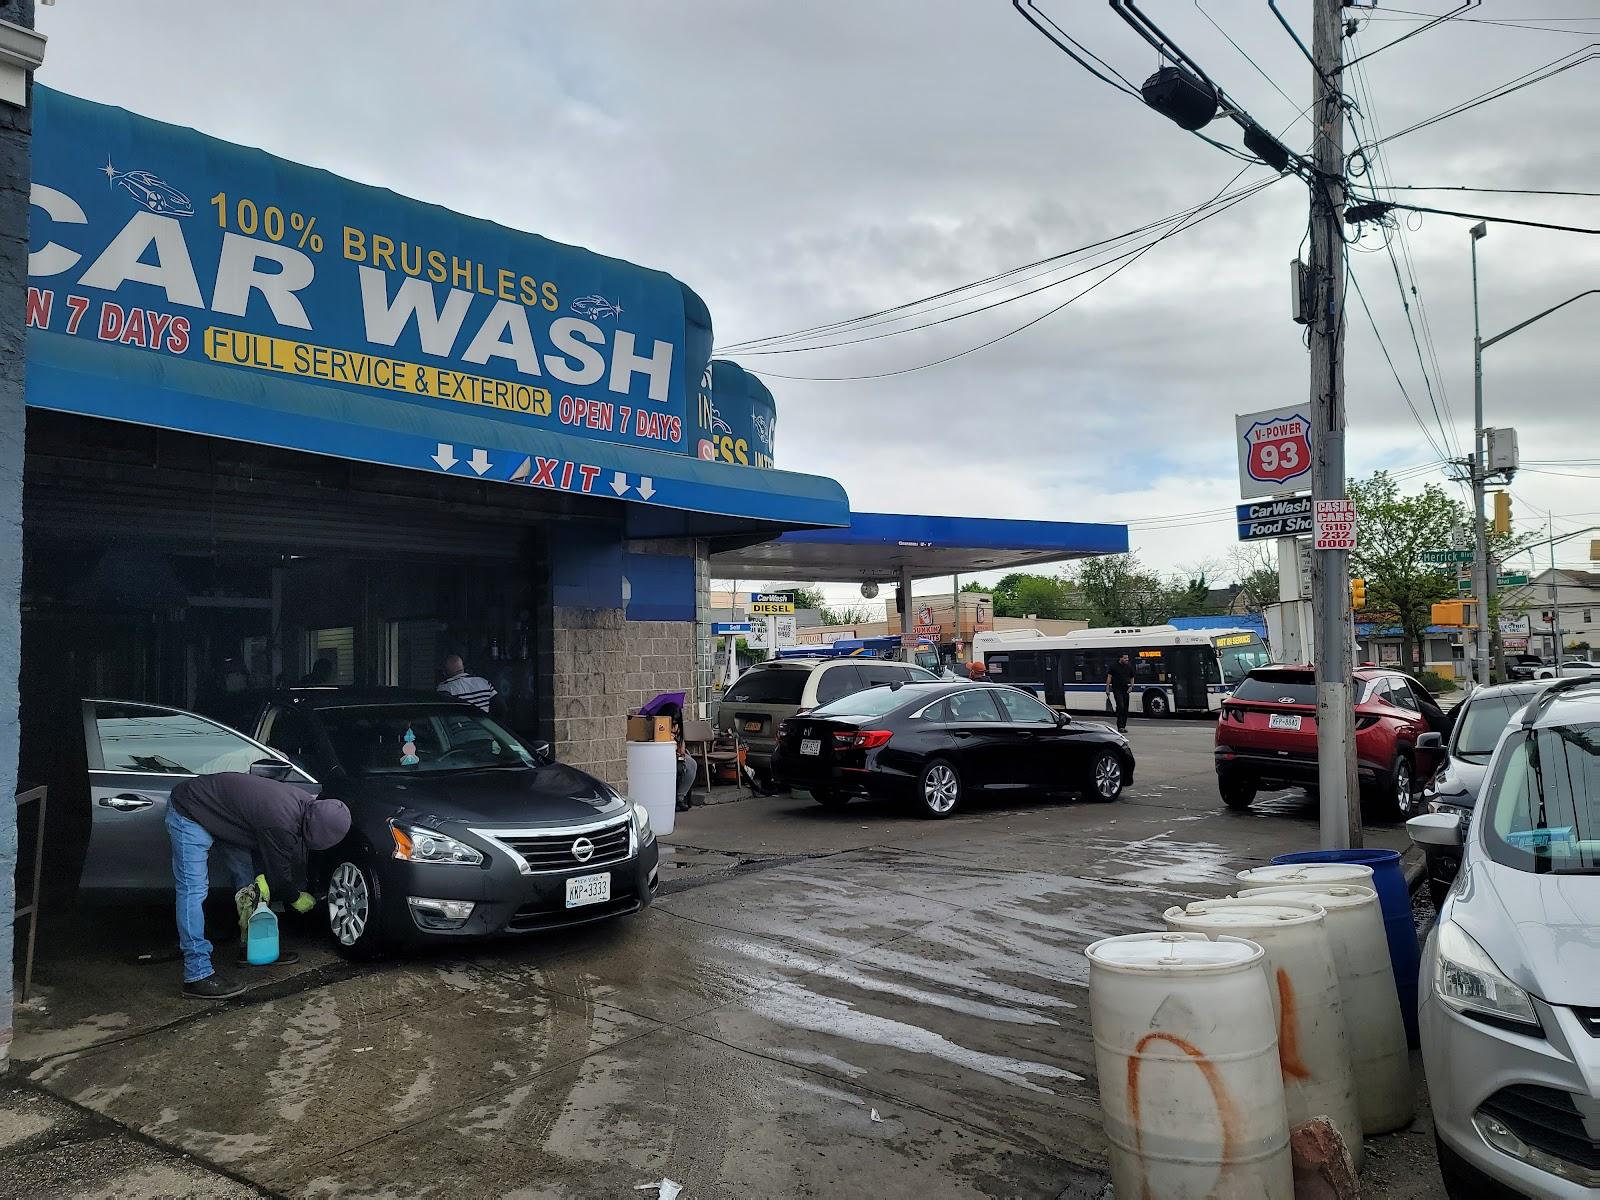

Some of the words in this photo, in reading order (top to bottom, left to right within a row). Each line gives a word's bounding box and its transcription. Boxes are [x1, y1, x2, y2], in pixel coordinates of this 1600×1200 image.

[211, 192, 324, 253] 100%
[343, 226, 559, 312] BRUSHLESS
[66, 296, 90, 334] 7
[98, 301, 190, 353] DAYS
[358, 265, 673, 402] WASH
[212, 329, 285, 370] FULL
[294, 344, 406, 390] SERVICE
[414, 366, 430, 394] &
[437, 370, 547, 414] EXTERIOR
[559, 395, 614, 431] OPEN
[619, 406, 631, 433] 7
[636, 409, 681, 443] DAYS
[1255, 422, 1301, 440] V-POWER
[1260, 441, 1299, 472] 93
[528, 456, 601, 493] XIT
[1249, 499, 1311, 518] CarWash
[1318, 501, 1347, 512] CASH
[1249, 519, 1282, 536] Food
[1285, 517, 1312, 532] Sho
[1317, 512, 1354, 522] CARS
[1320, 523, 1352, 531] (516)
[1423, 552, 1458, 562] Merrick
[757, 594, 787, 602] CarWash
[753, 604, 790, 612] DIESEL
